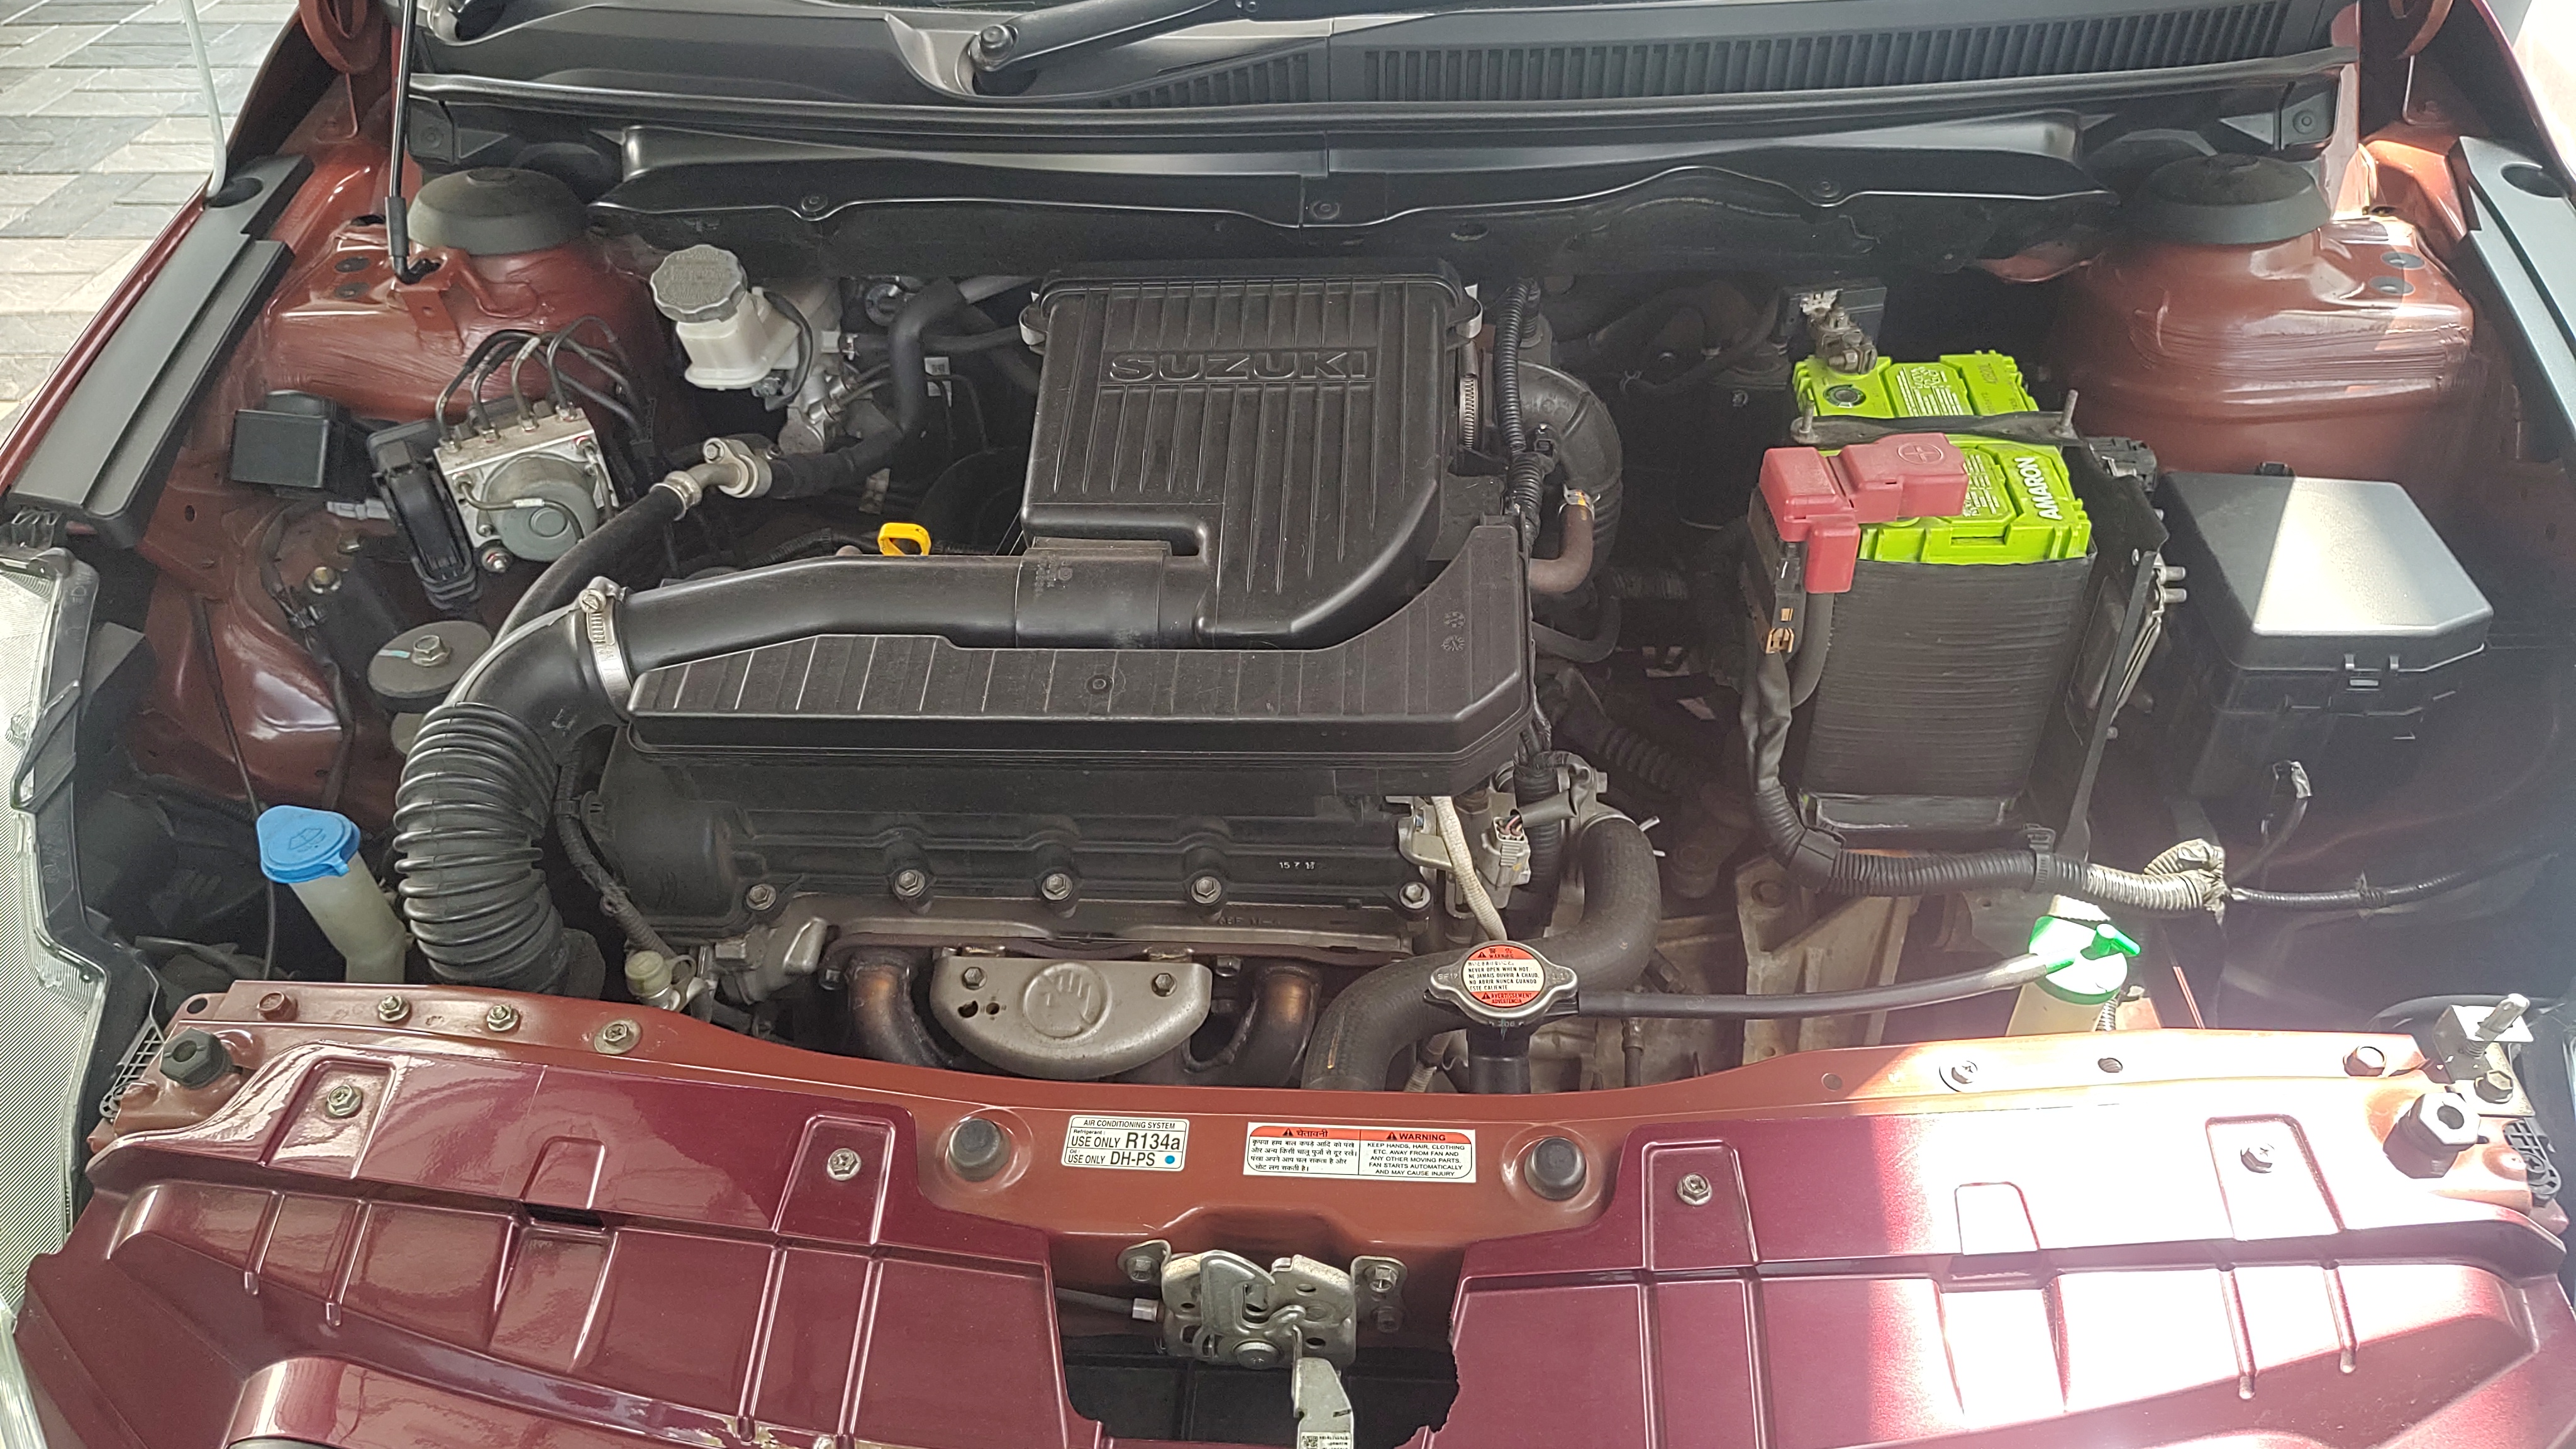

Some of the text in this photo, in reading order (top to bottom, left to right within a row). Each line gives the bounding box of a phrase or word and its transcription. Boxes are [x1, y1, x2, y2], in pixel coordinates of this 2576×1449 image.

[1109, 351, 1367, 382] SUZUKI
[2014, 457, 2063, 520] AMARON
[1097, 1120, 1146, 1128] CONDITIONING
[1296, 1129, 1328, 1137] चेतावनी
[1399, 1133, 1445, 1141] WARNING
[1072, 1132, 1180, 1150] USE ONLY R134a
[1069, 1151, 1155, 1166] USE ONLY DH-PS
